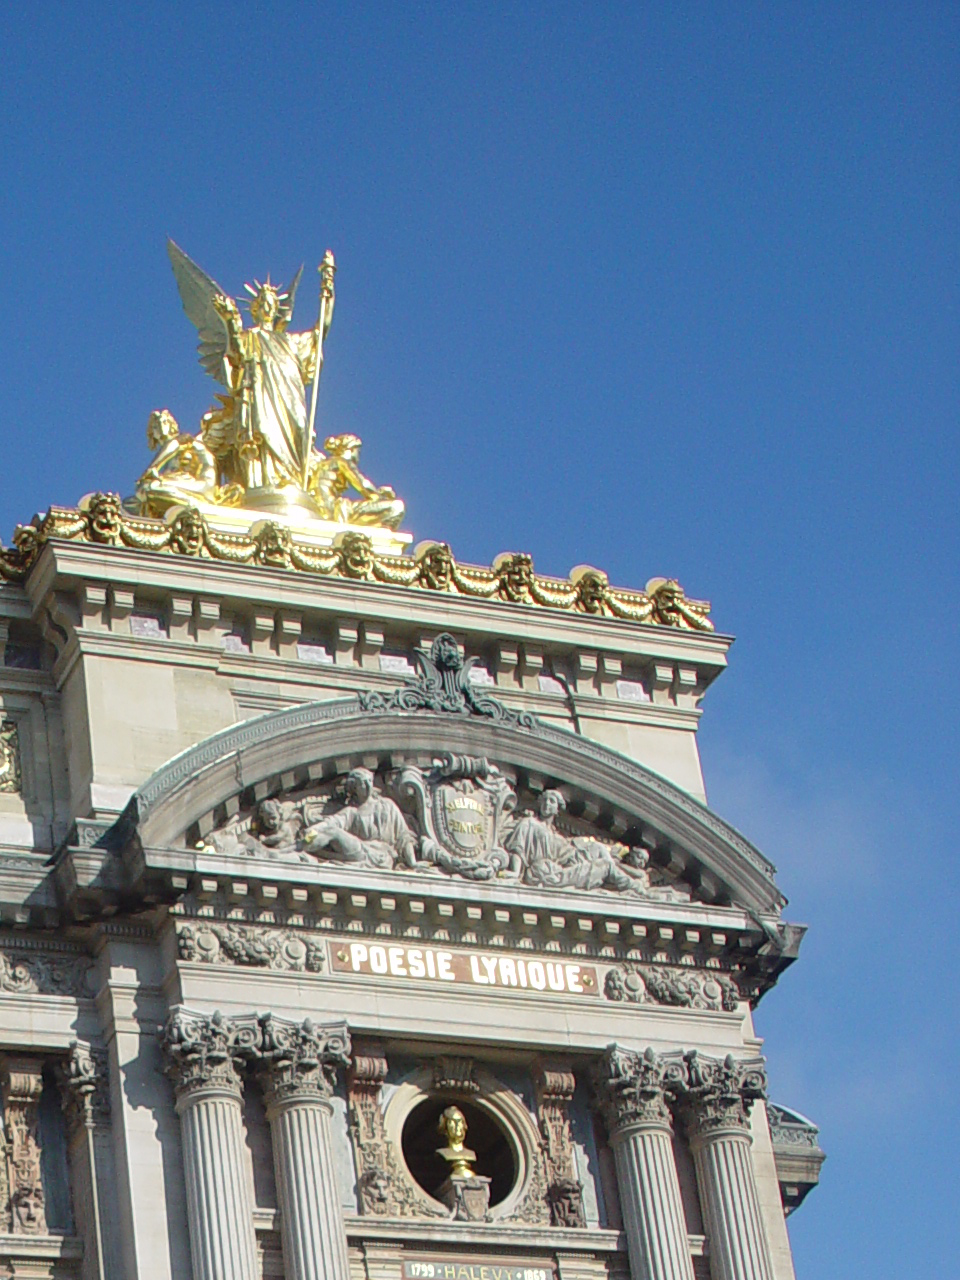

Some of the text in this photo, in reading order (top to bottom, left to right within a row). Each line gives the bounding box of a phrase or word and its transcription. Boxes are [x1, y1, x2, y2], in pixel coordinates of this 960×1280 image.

[350, 943, 584, 993] POESIE LYRIQUE
[411, 1263, 435, 1278] 1799
